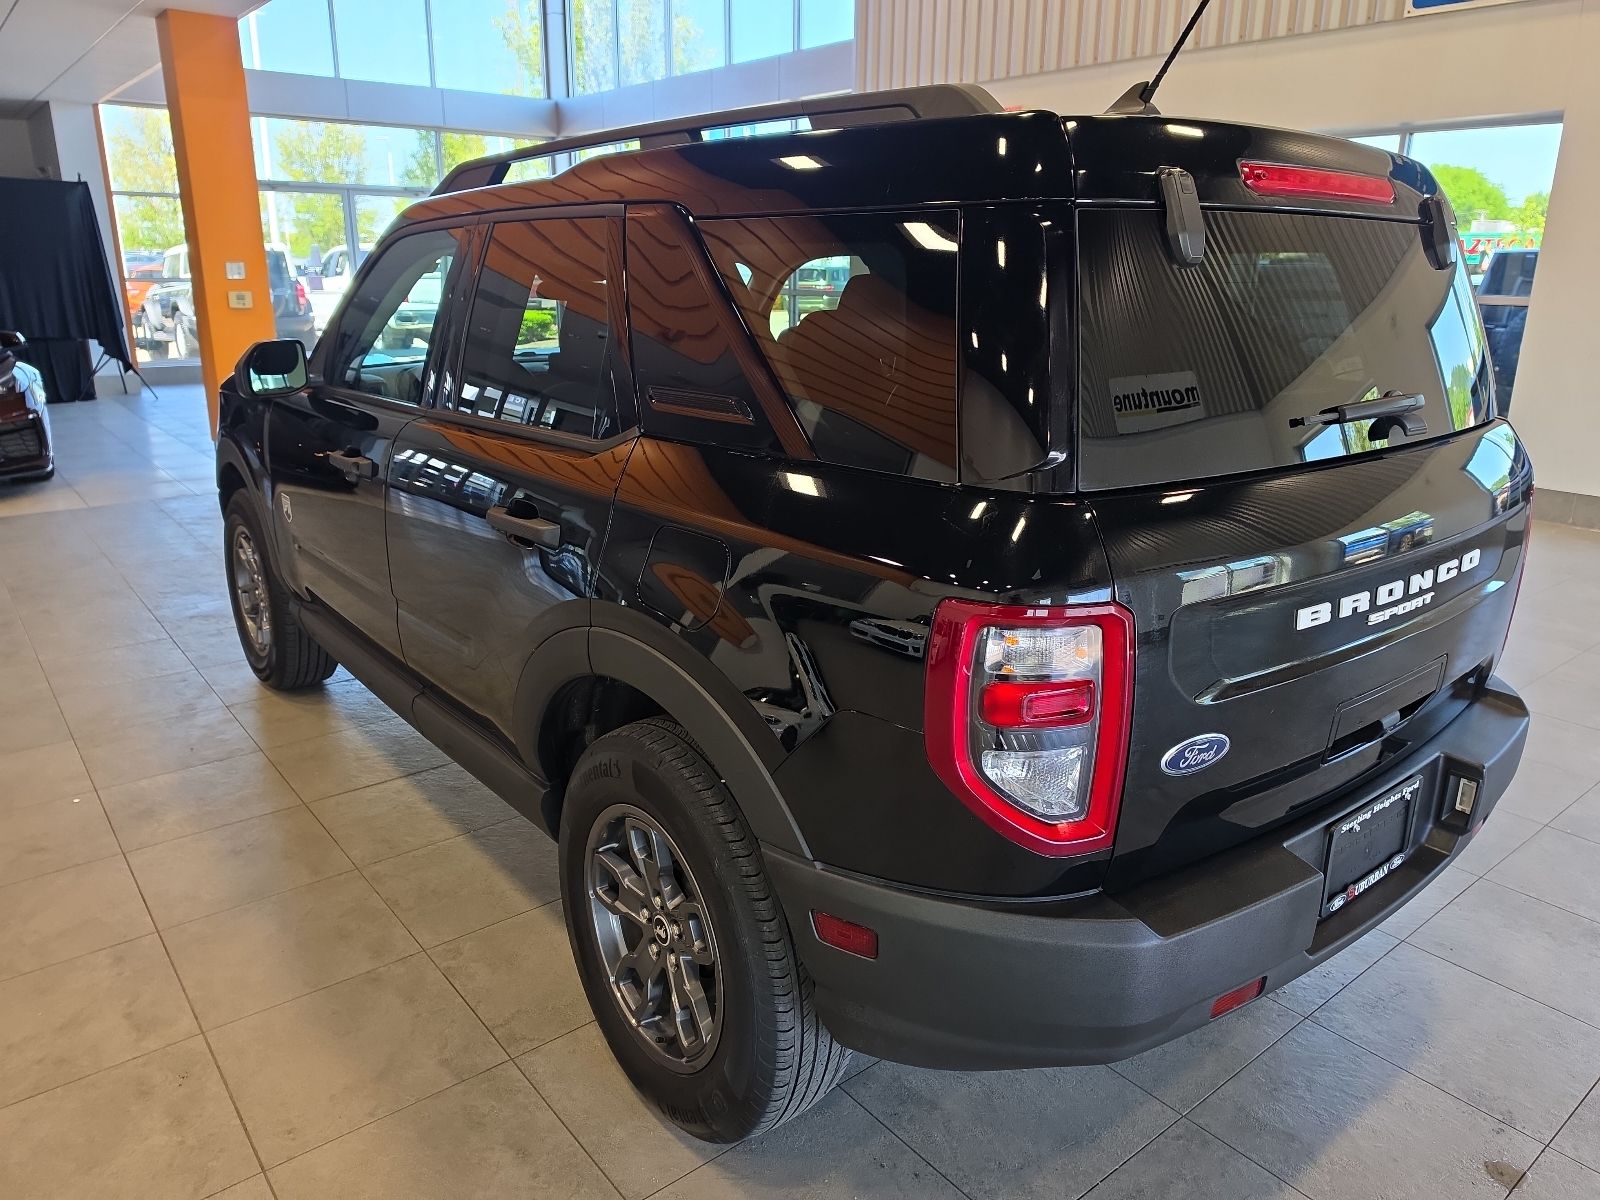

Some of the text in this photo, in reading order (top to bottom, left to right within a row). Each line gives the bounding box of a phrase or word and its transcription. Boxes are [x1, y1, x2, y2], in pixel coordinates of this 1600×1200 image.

[1296, 549, 1481, 630] BRONCO
[1367, 592, 1435, 625] SPORT
[1179, 743, 1218, 768] Ford
[1340, 780, 1420, 834] Sterling Heights Ford
[1348, 863, 1390, 901] SUBURBAN
